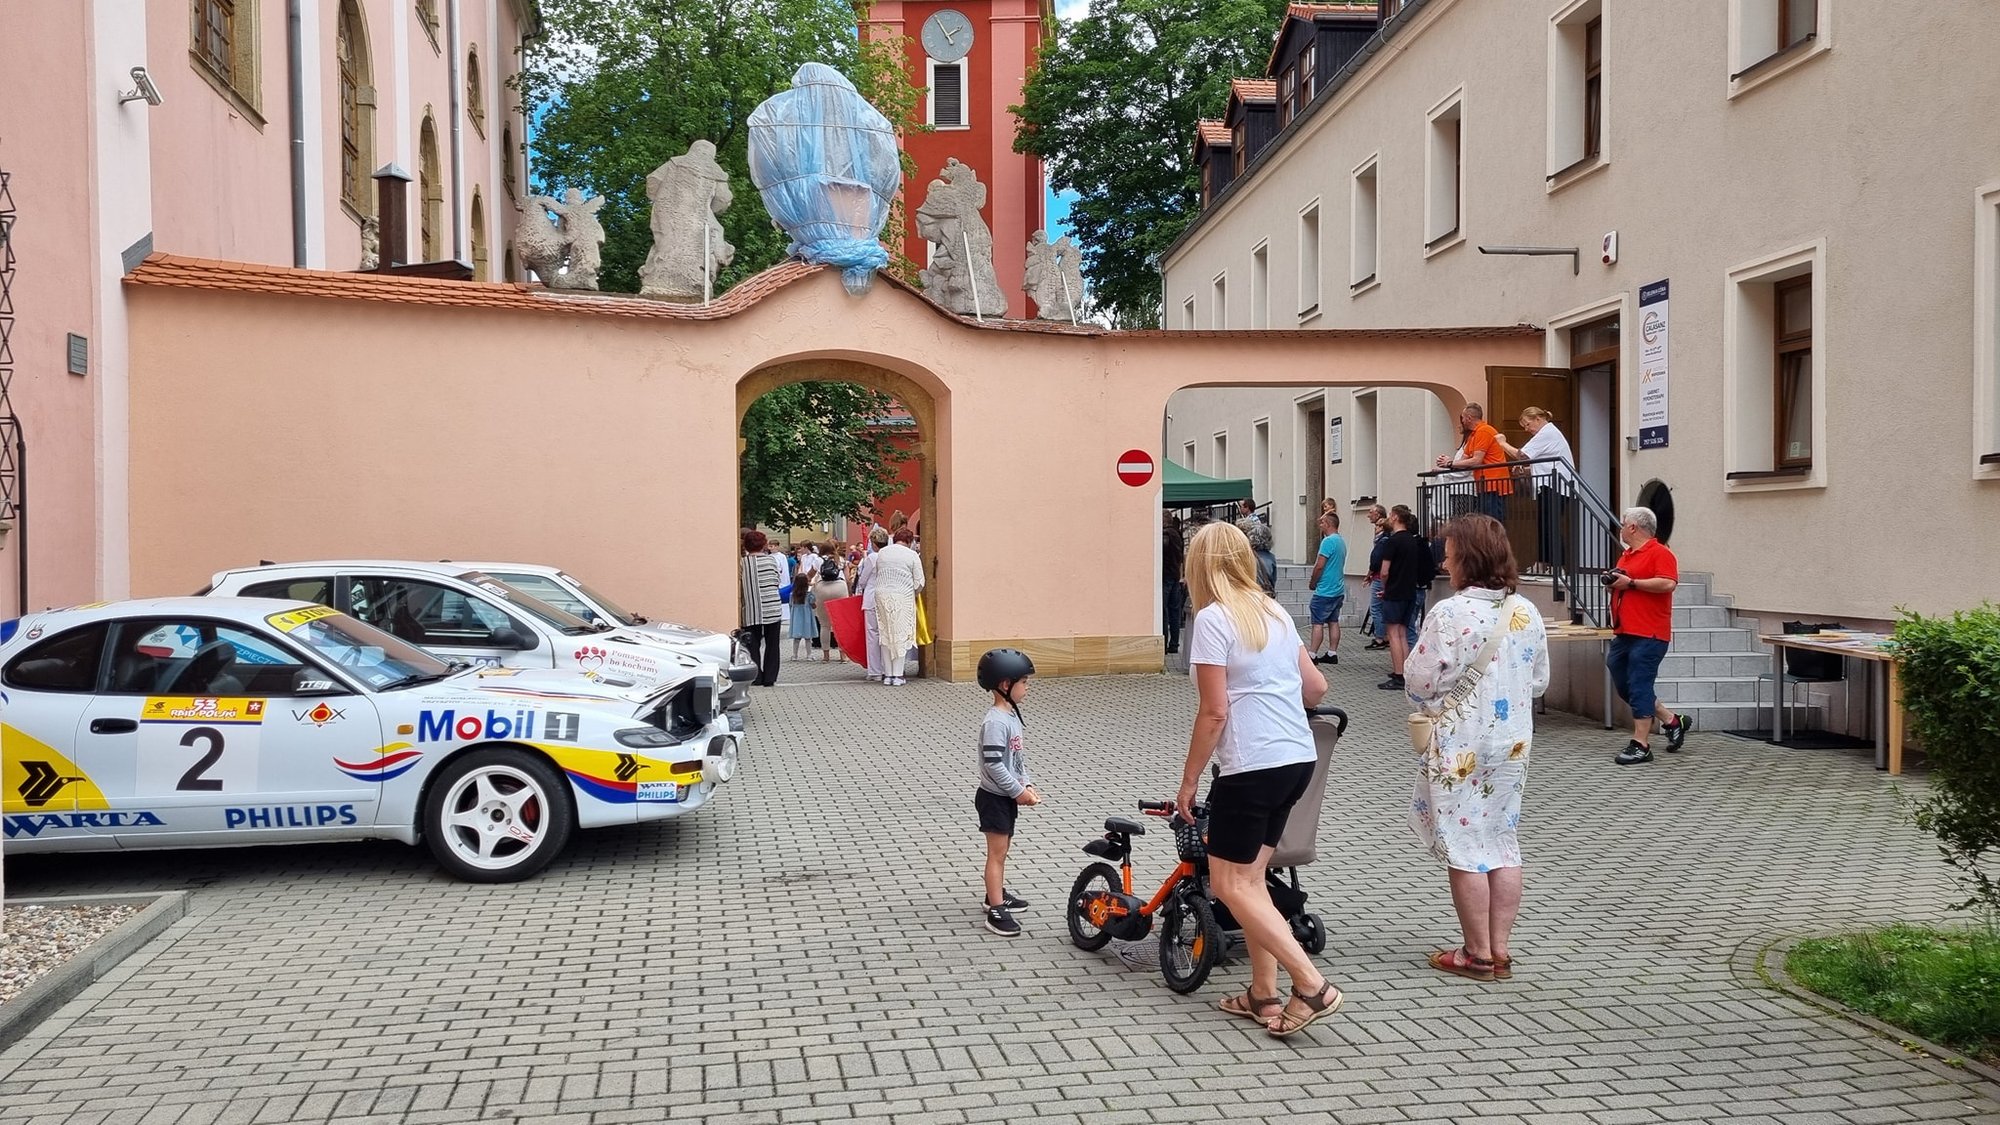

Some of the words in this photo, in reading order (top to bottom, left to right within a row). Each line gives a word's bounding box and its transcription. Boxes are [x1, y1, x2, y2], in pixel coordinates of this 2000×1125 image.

[611, 650, 656, 666] Pomagamy
[622, 660, 658, 677] kochamy
[193, 699, 217, 712] 53
[198, 708, 236, 718] POLSKI
[291, 704, 347, 723] VOX
[418, 709, 535, 742] Mobil
[176, 726, 225, 792] 2
[639, 782, 675, 790] WARTA
[637, 791, 675, 799] PHILIPS
[3, 811, 167, 838] WARTA
[225, 804, 357, 829] PHILIPS
